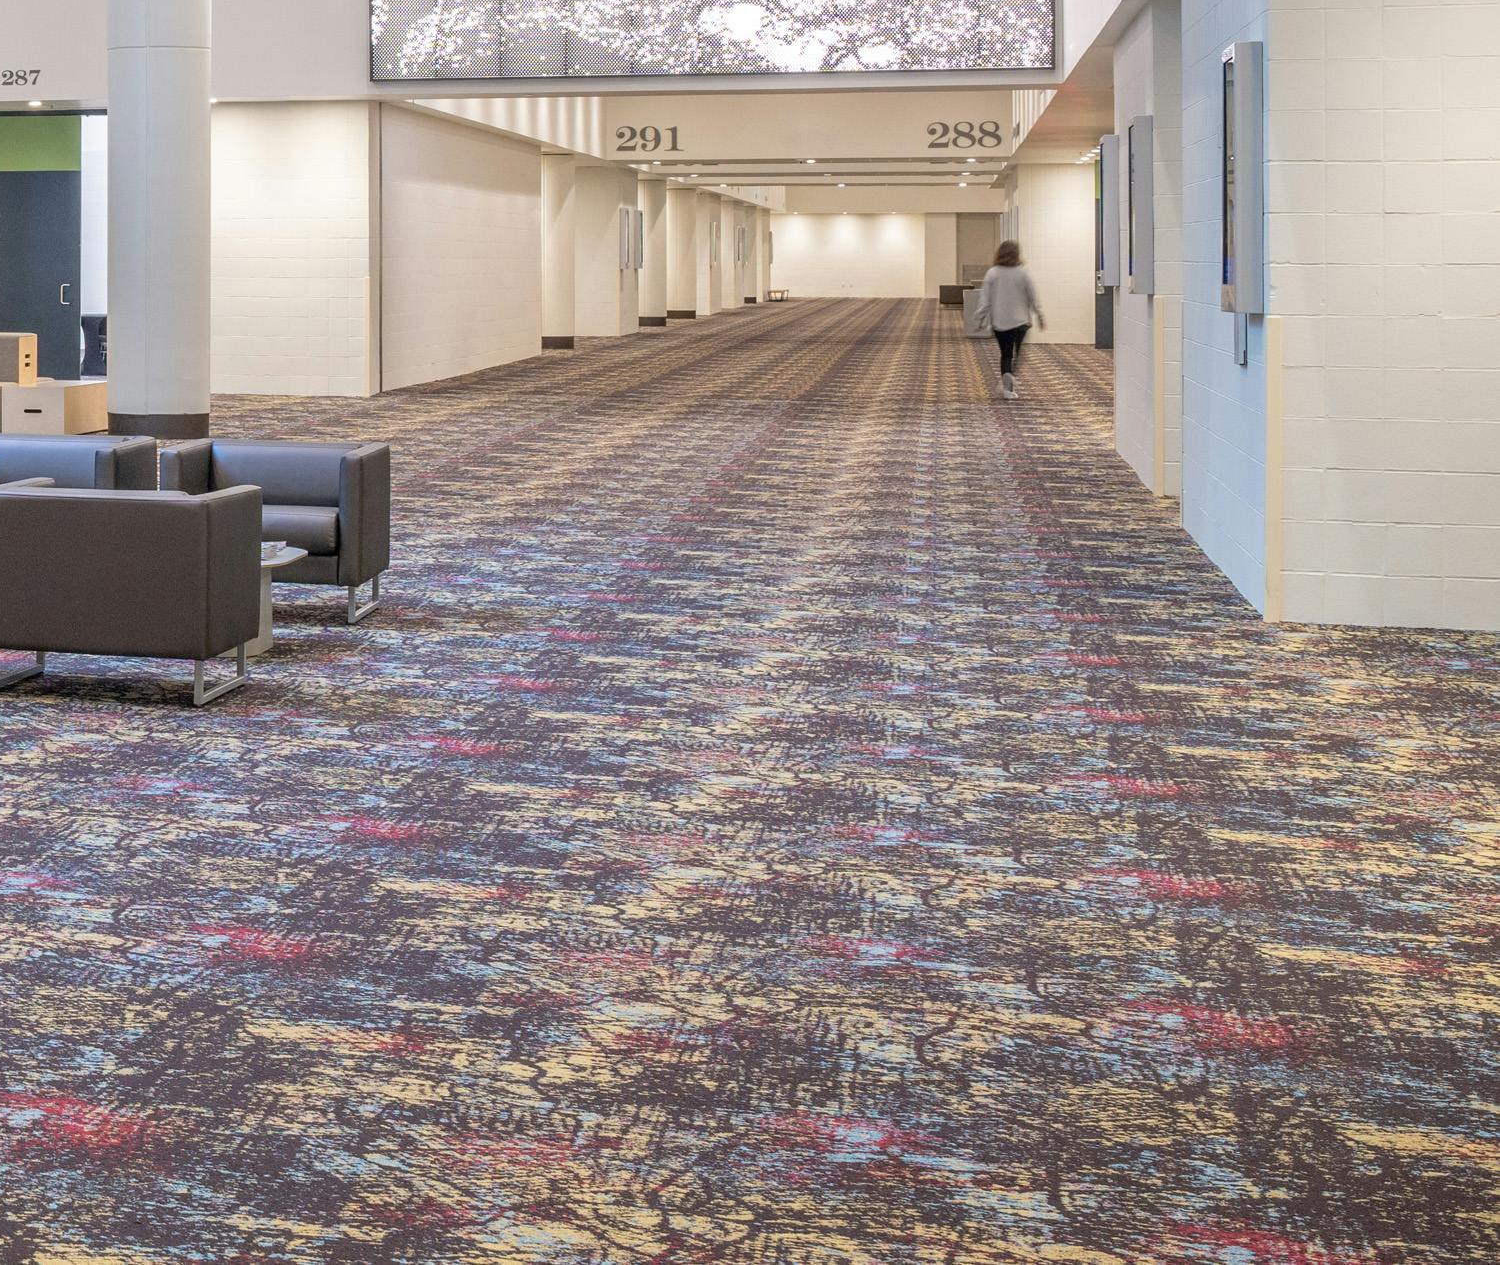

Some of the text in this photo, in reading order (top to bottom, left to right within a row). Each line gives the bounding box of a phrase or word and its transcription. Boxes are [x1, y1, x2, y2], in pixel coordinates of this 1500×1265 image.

[1, 69, 41, 86] 287
[615, 125, 685, 152] 291
[926, 120, 1002, 149] 288
